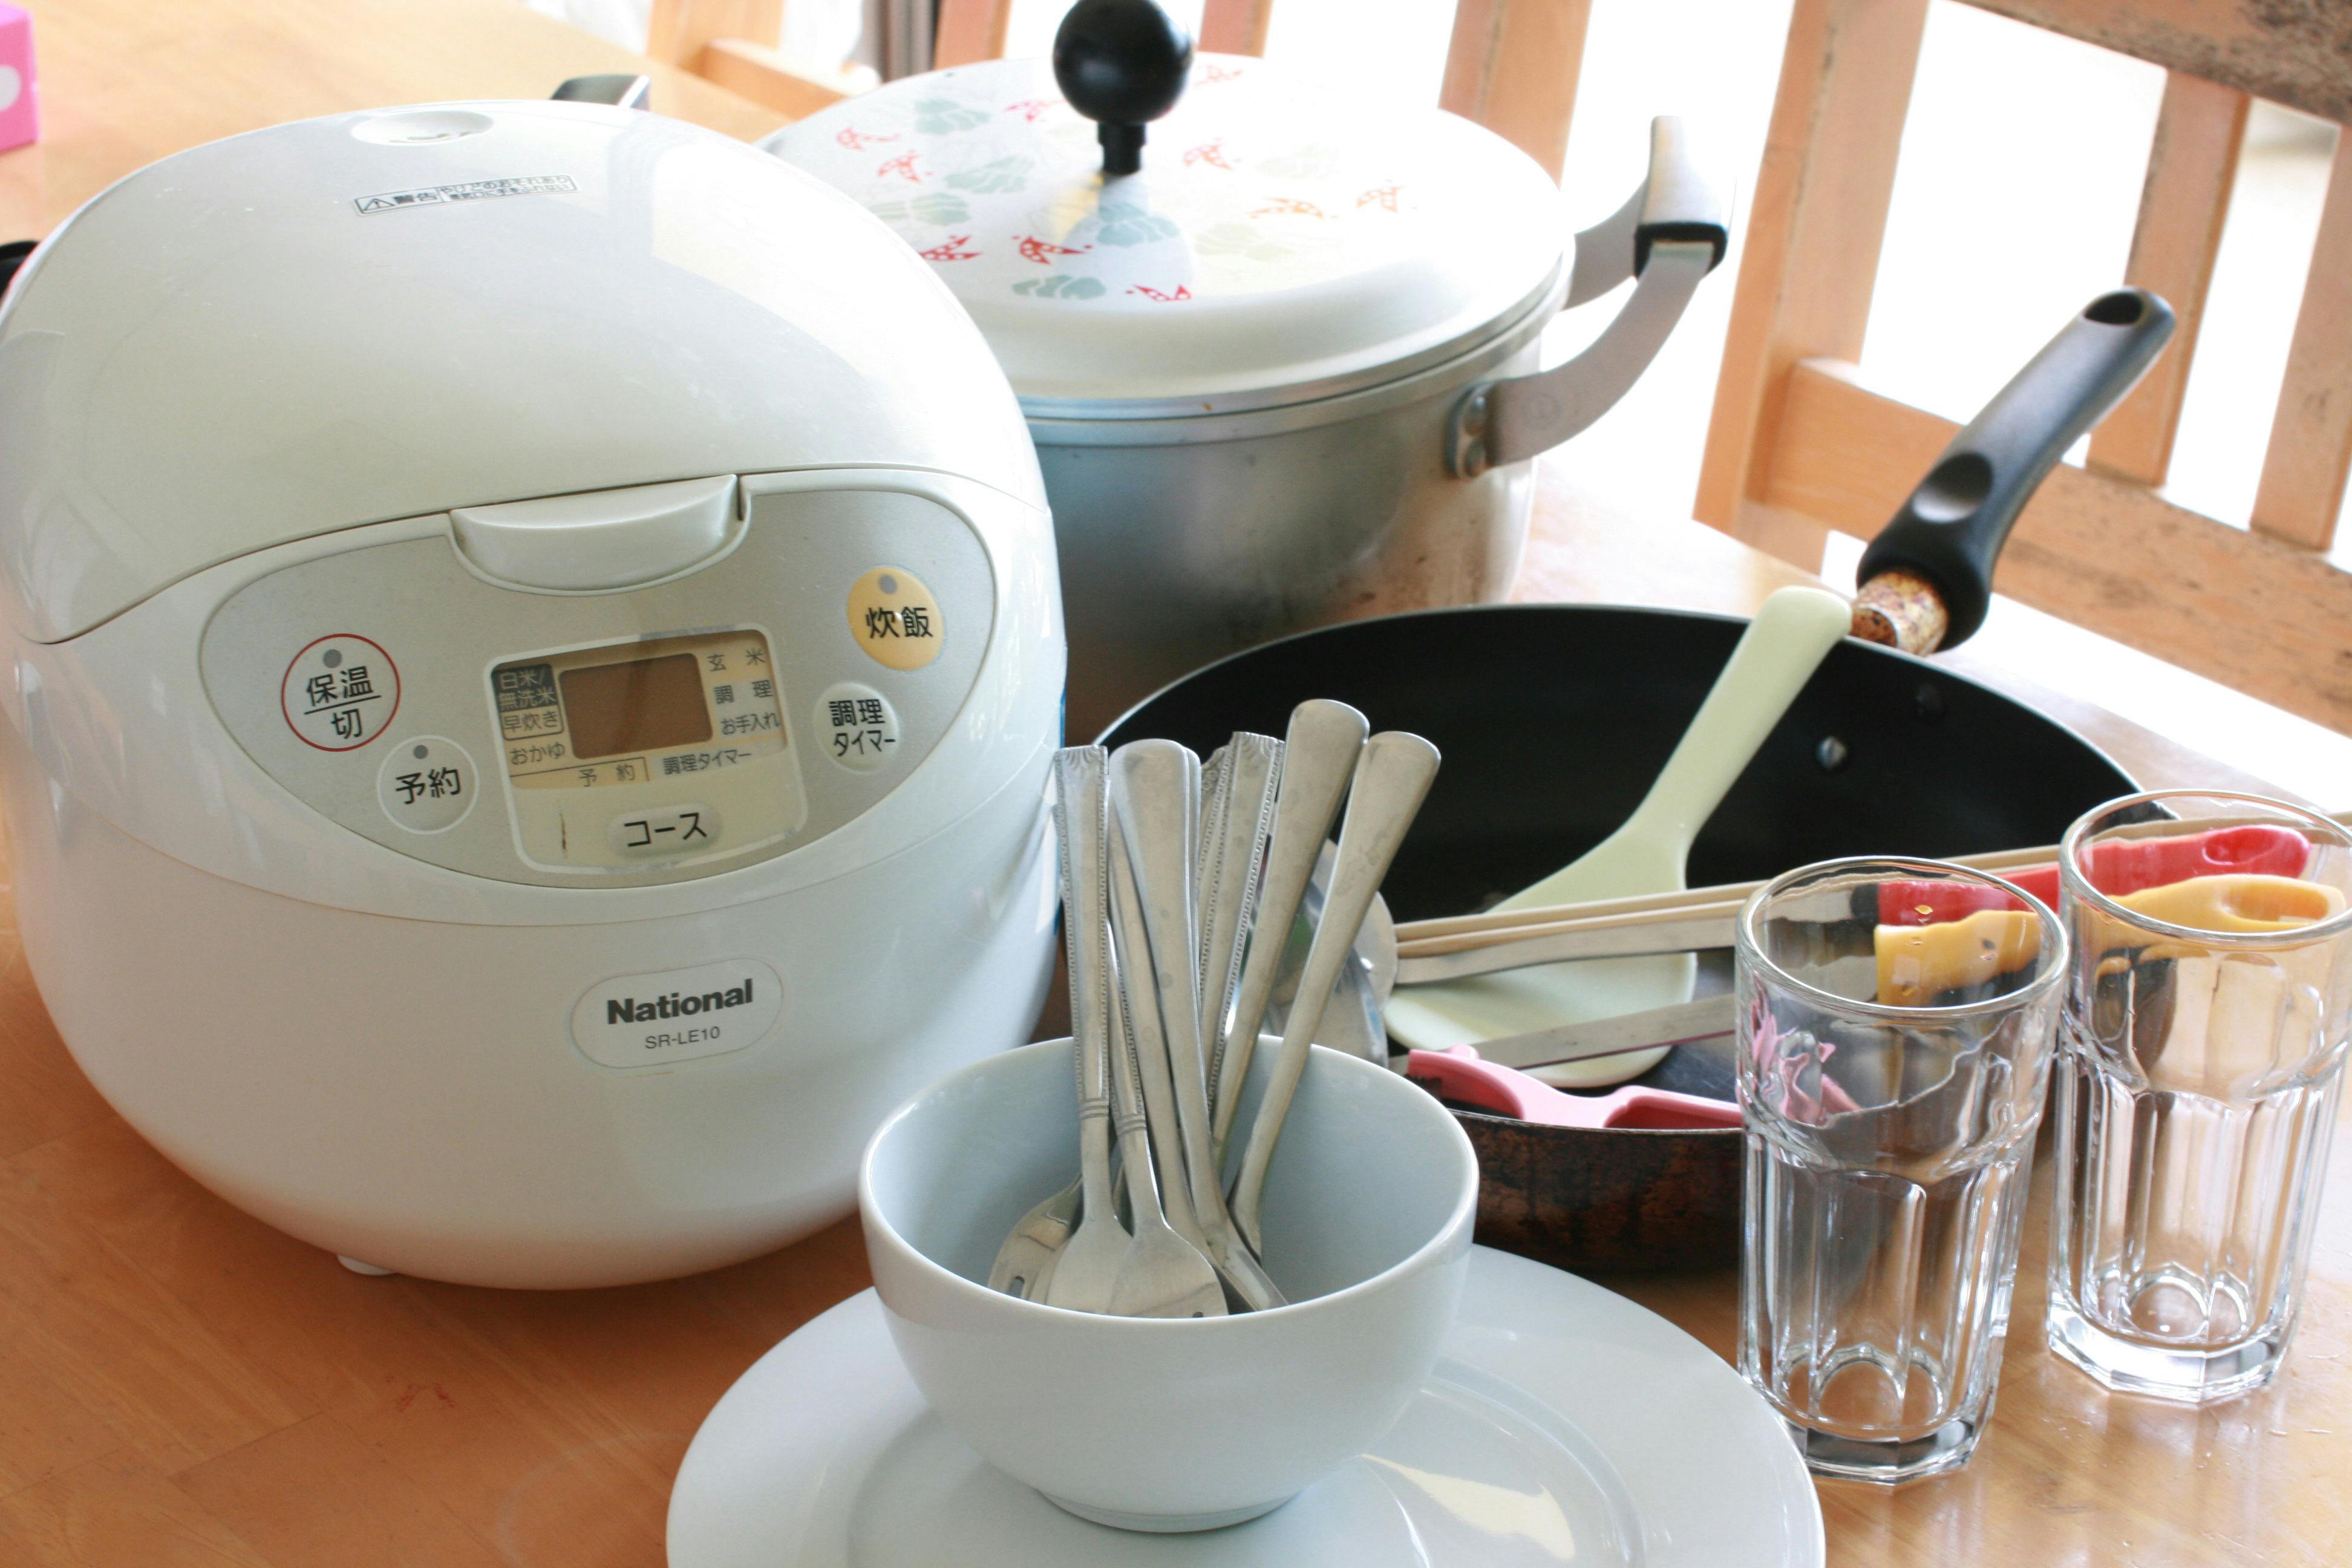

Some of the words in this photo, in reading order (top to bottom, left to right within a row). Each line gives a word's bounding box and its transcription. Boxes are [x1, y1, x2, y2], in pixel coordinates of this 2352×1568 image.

[866, 606, 933, 638] 炊飯
[306, 666, 373, 706] 保温
[331, 708, 362, 739] 切
[503, 710, 558, 733] 早炊き
[720, 712, 780, 735] お手入れ
[829, 699, 885, 727] 調理
[511, 742, 565, 765] おかゆ
[834, 730, 896, 756] タイマー
[662, 750, 751, 775] 調理タイマー
[396, 766, 461, 805] 予約
[624, 812, 707, 847] コース
[607, 978, 753, 1024] National
[645, 1027, 720, 1049] SR-LE10
